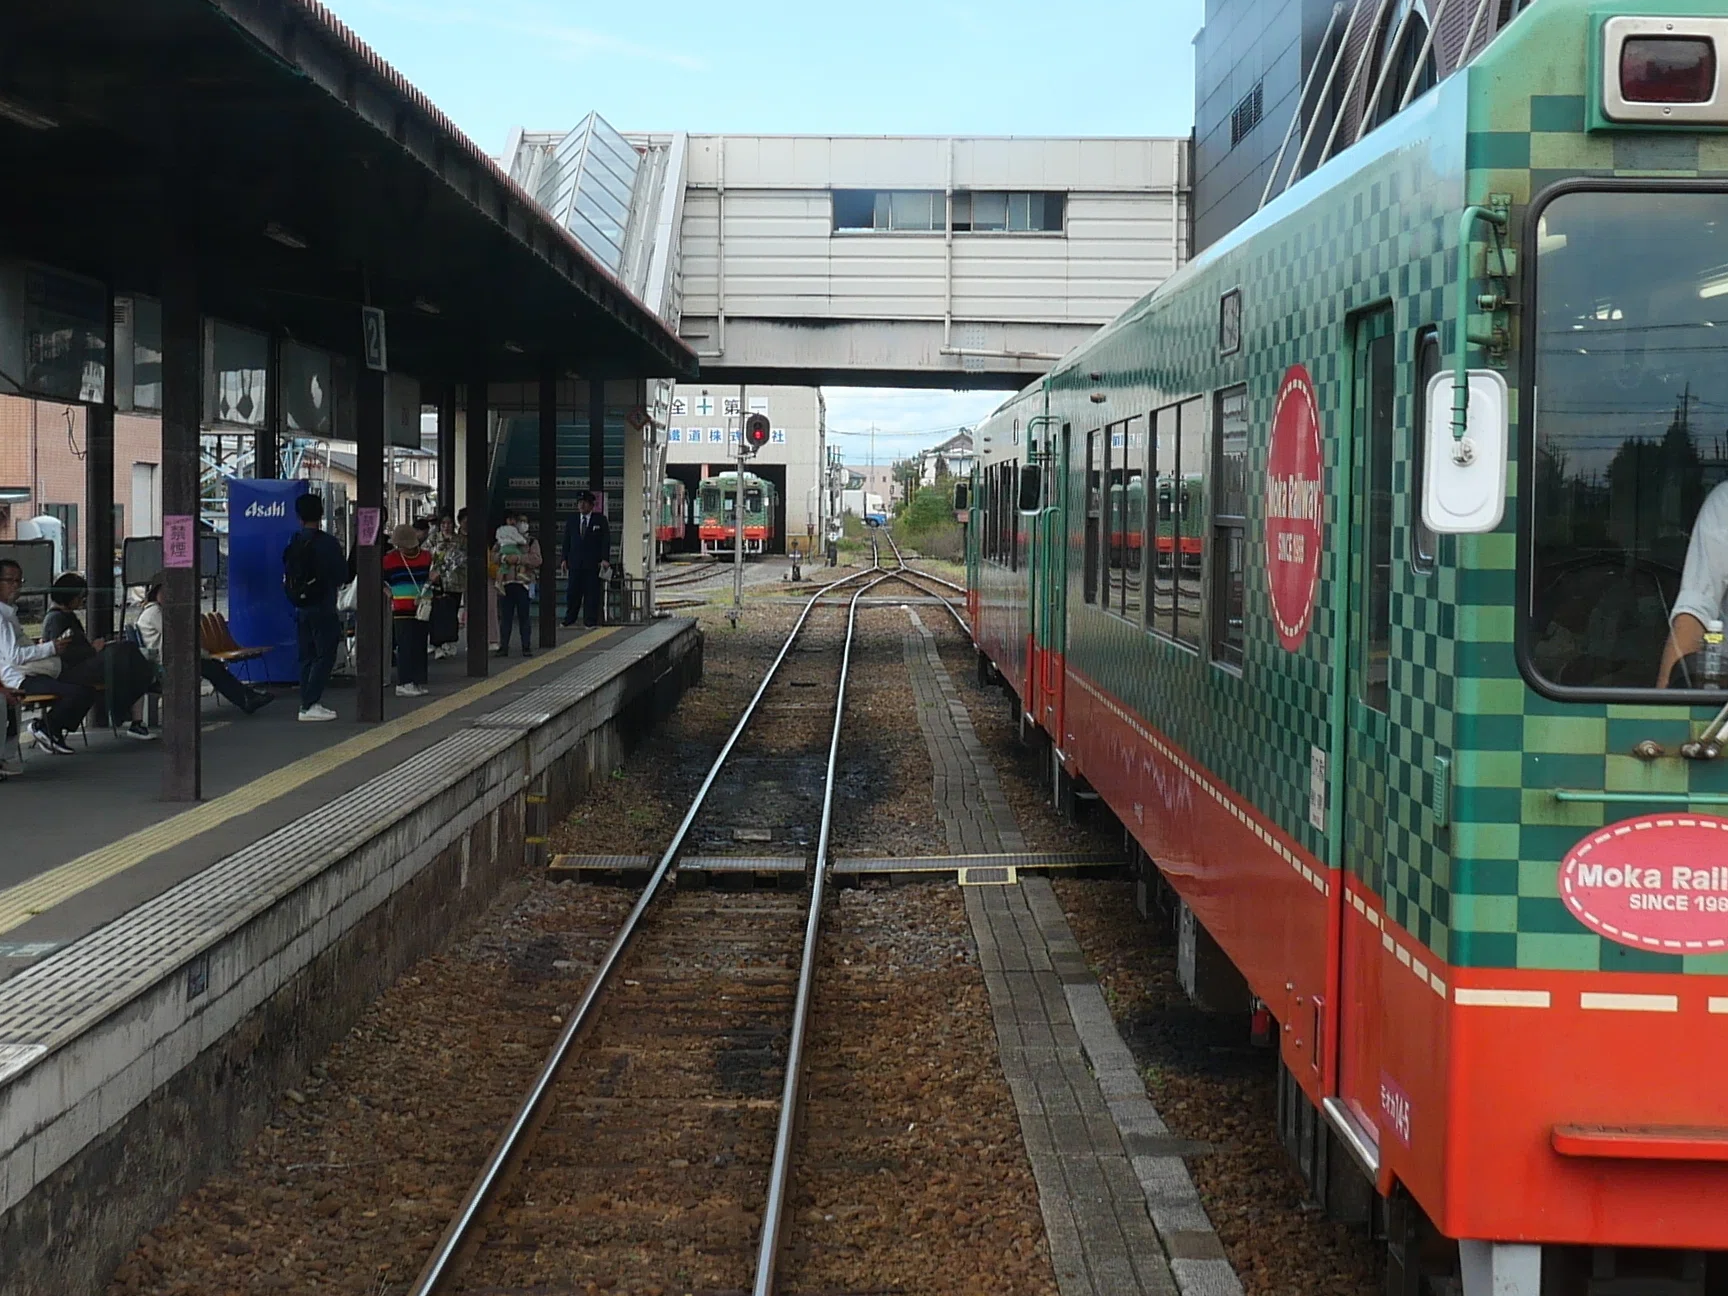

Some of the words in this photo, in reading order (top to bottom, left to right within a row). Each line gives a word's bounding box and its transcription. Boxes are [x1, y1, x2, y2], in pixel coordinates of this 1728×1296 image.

[367, 316, 379, 358] 2
[245, 501, 286, 518] Asahi
[170, 525, 186, 557] 禁煙
[1578, 863, 1661, 889] Moka
[1629, 894, 1688, 911] SINCE
